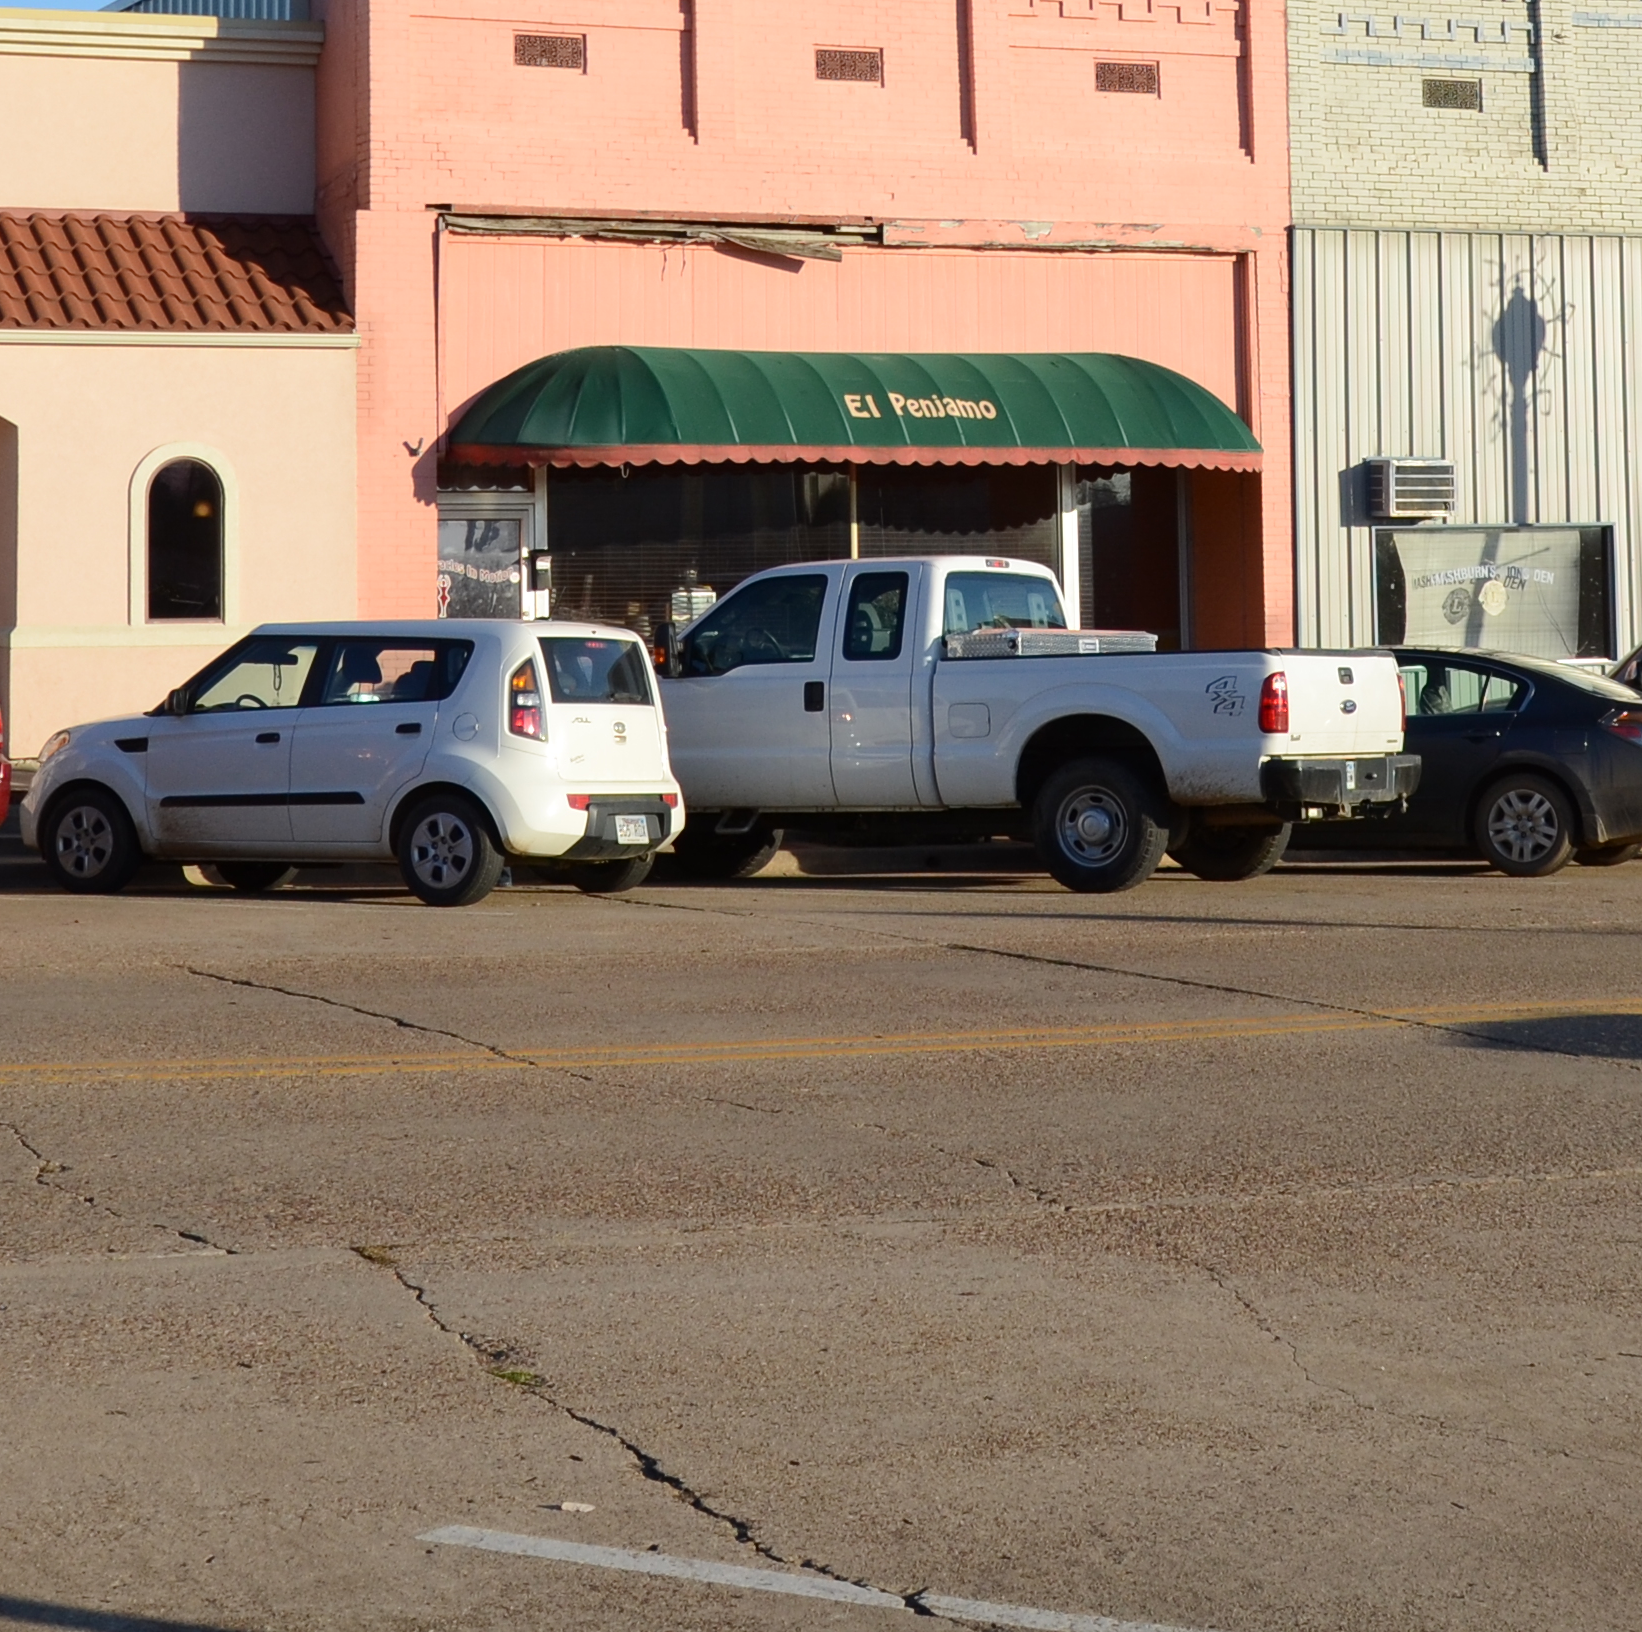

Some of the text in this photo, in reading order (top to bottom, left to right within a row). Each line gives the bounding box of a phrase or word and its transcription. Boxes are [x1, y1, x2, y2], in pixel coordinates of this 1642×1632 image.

[843, 391, 998, 420] El Penjamo
[437, 559, 465, 575] acles
[1533, 569, 1555, 585] DEN
